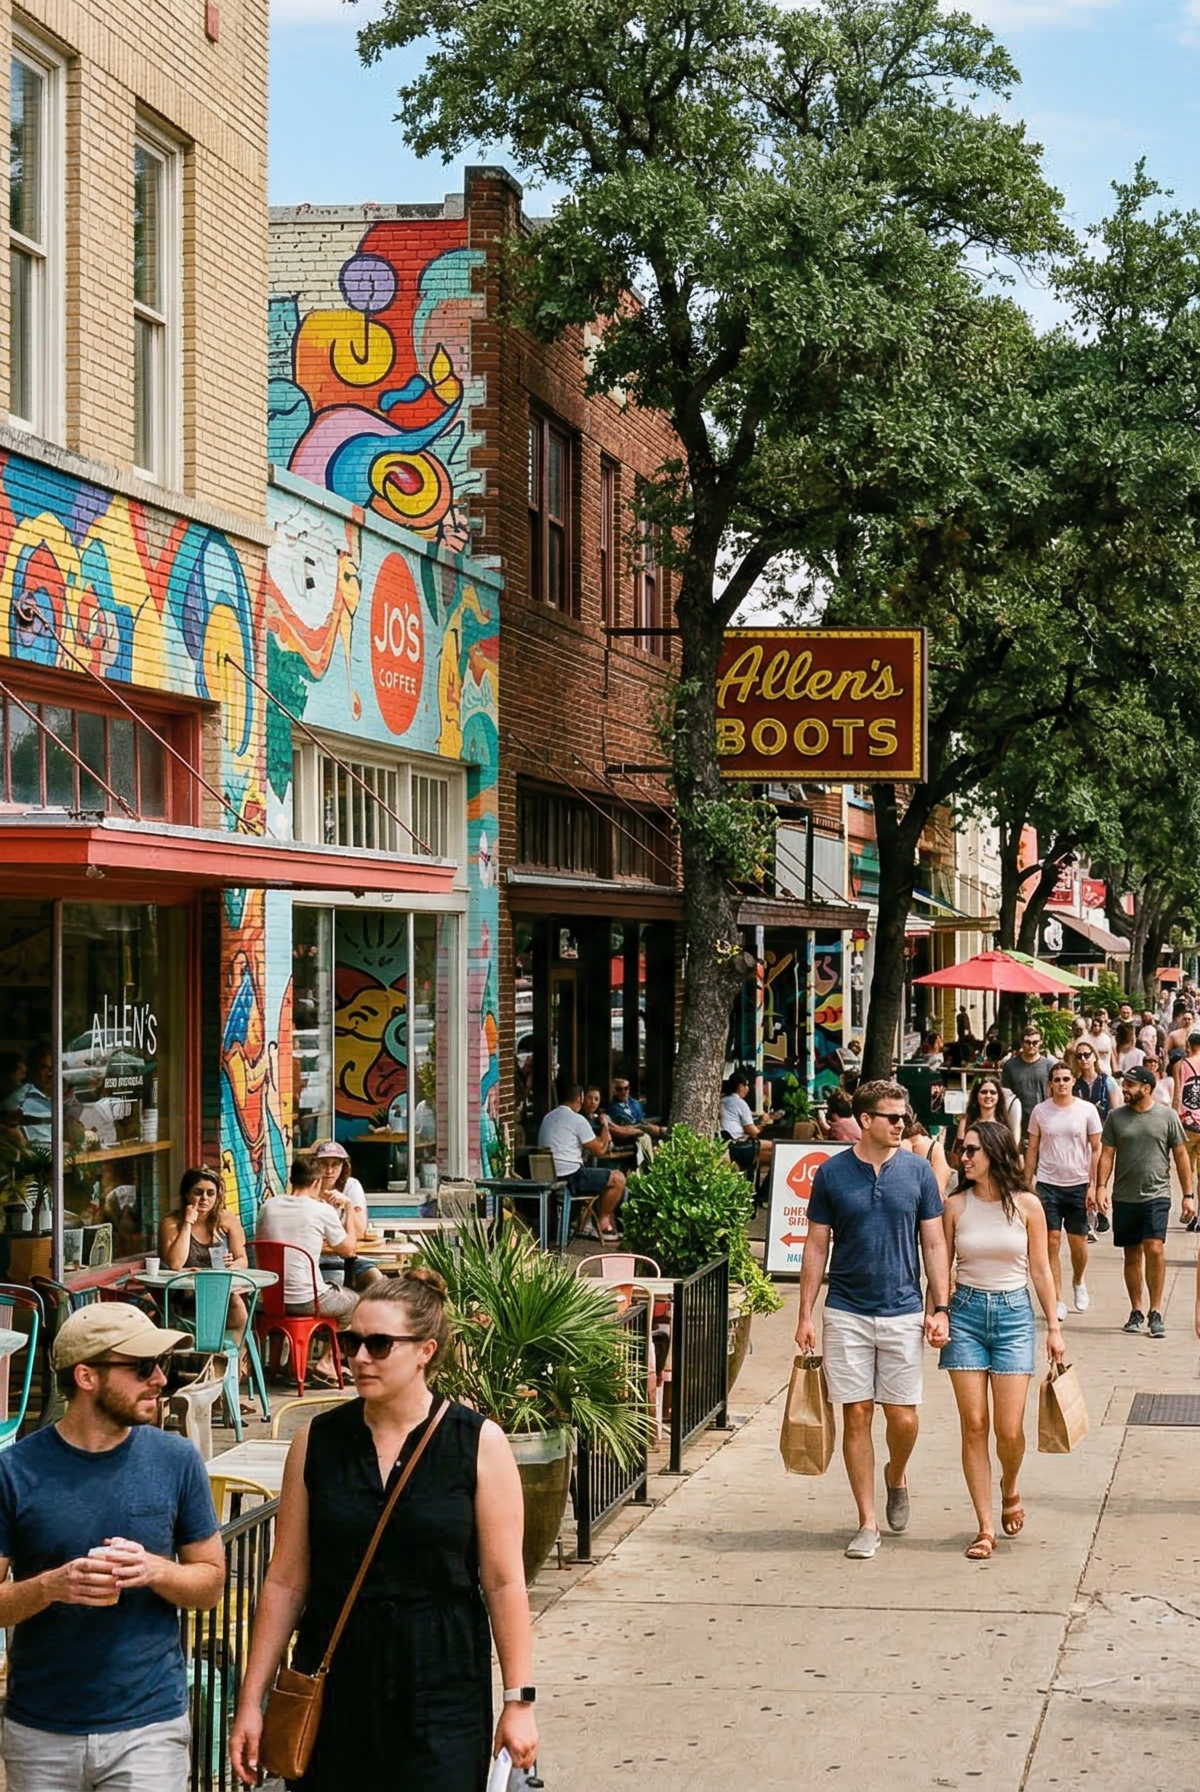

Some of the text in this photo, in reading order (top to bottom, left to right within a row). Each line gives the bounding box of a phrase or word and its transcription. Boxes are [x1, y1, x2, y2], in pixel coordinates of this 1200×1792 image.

[373, 602, 421, 663] JO'S
[379, 668, 417, 695] COFFEE
[716, 645, 904, 709] Allen's
[716, 717, 898, 756] BOOTS
[90, 990, 158, 1060] ALLEN'S
